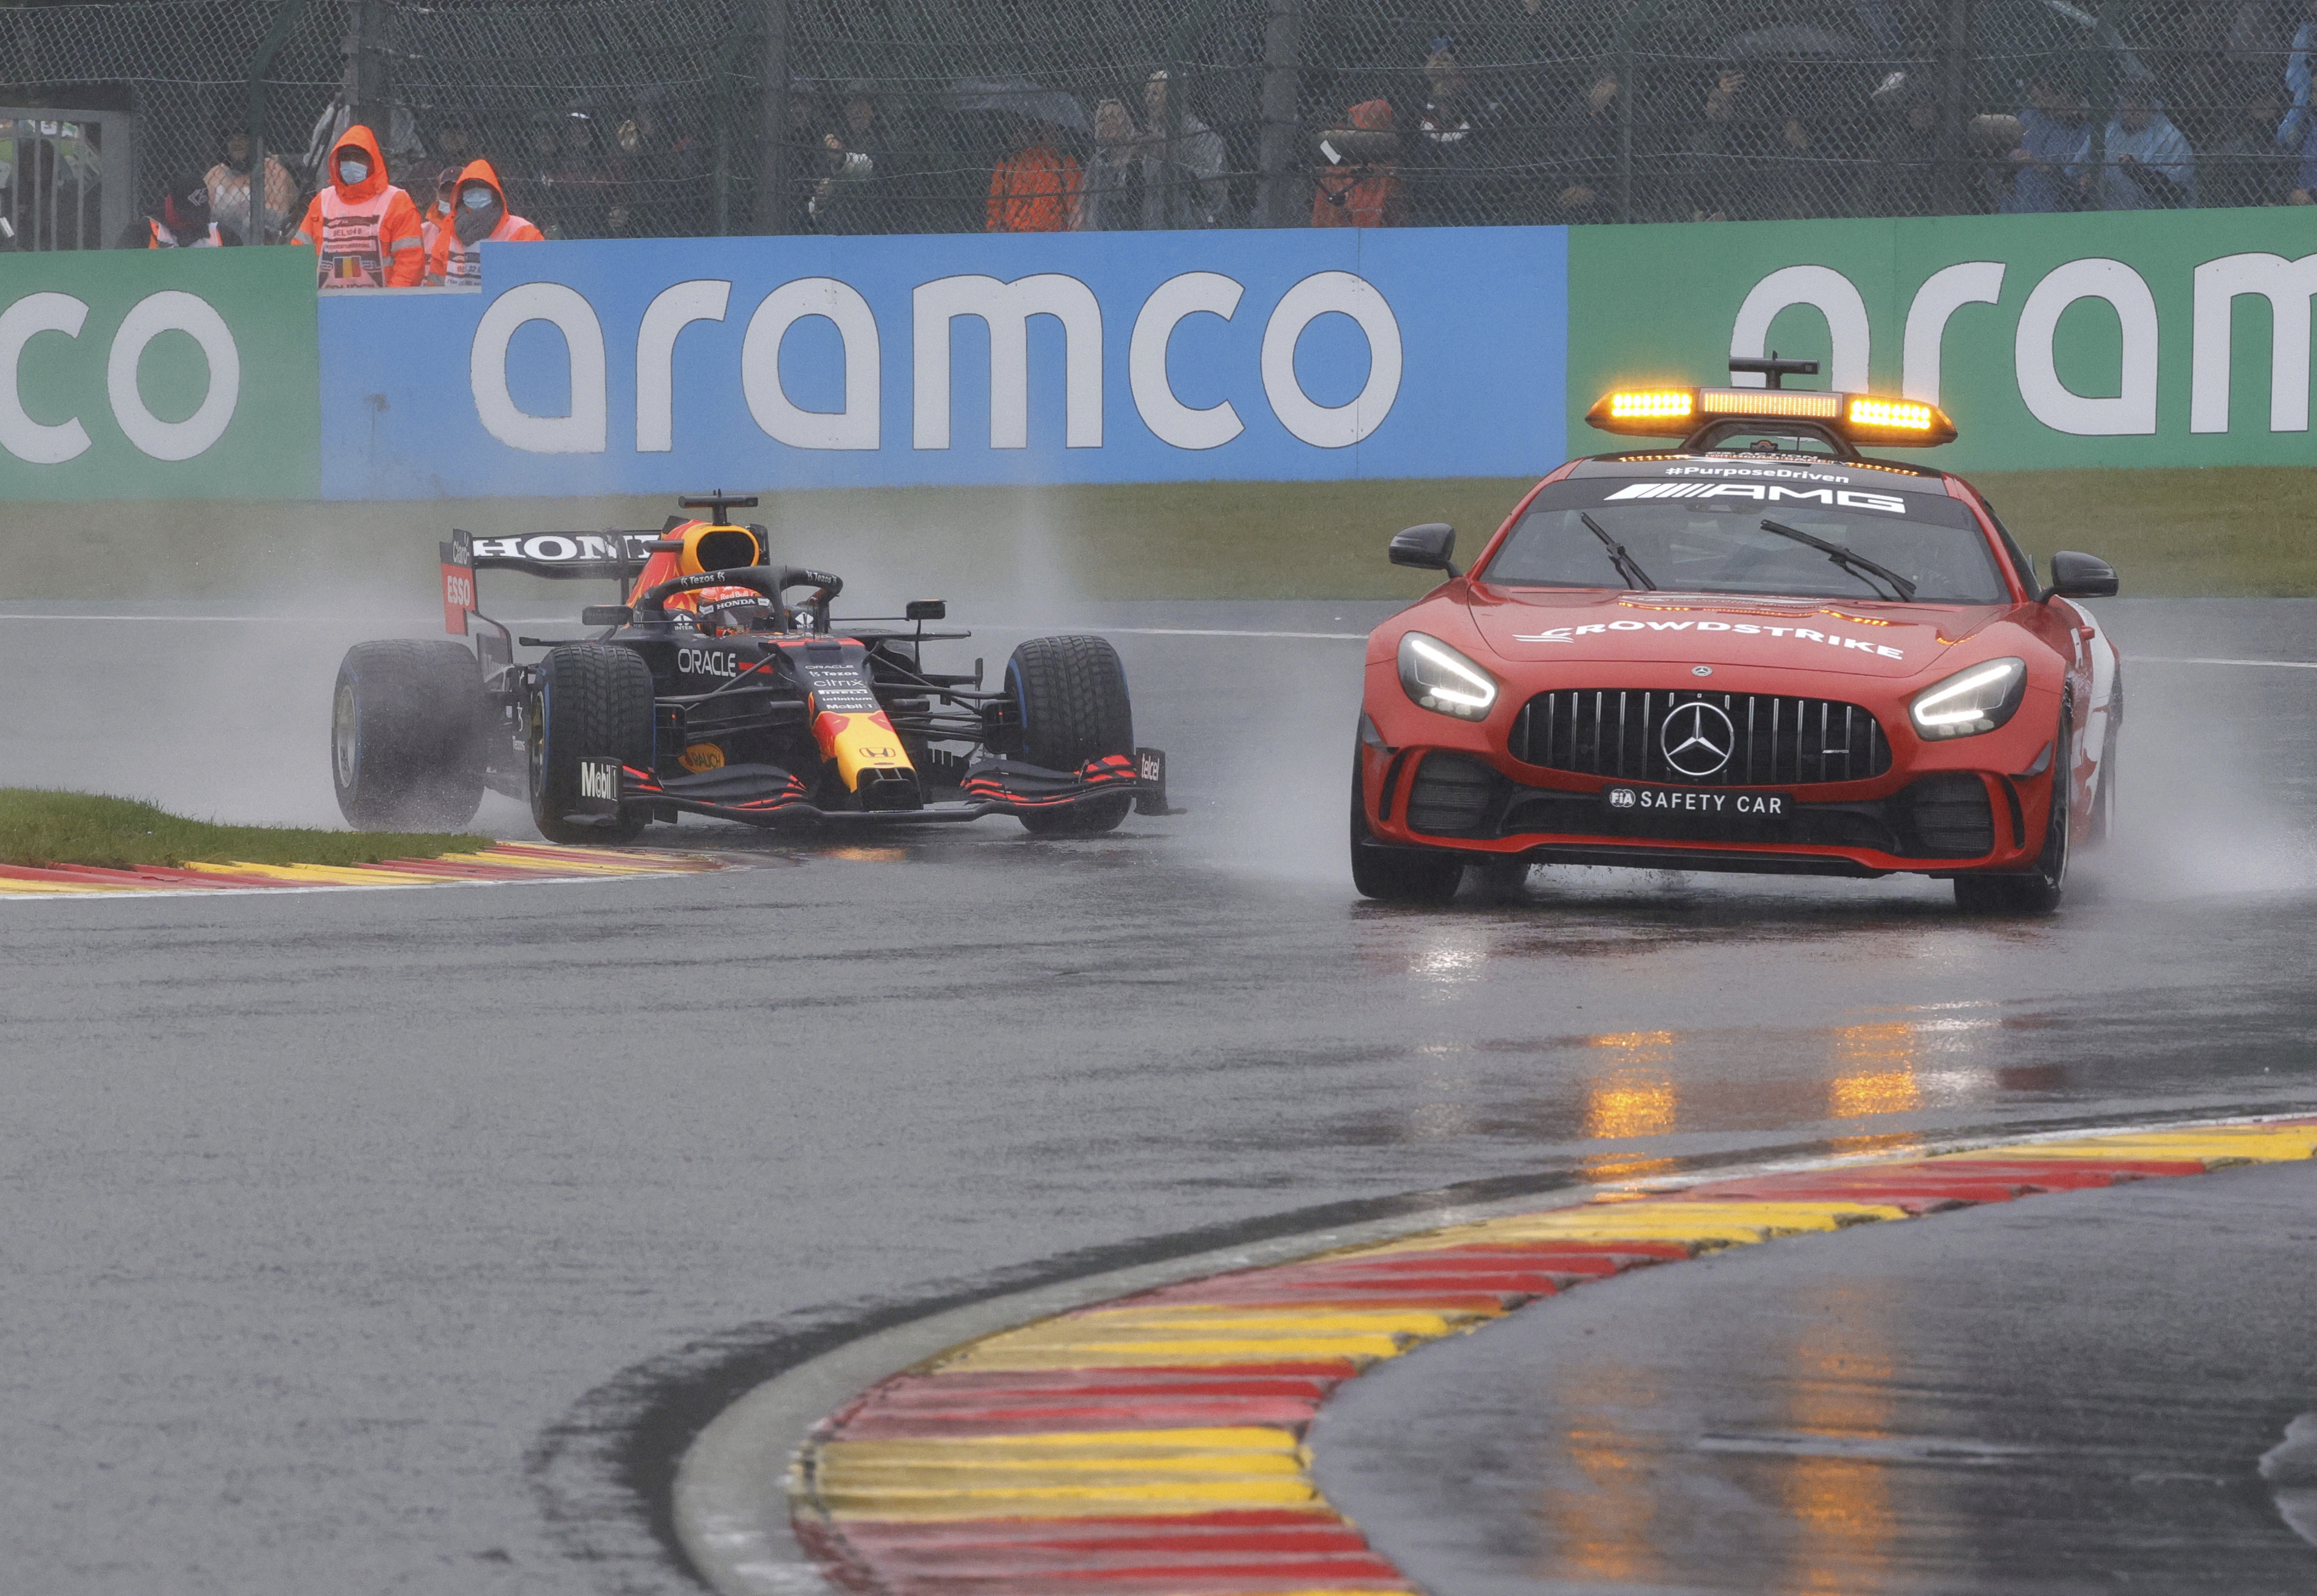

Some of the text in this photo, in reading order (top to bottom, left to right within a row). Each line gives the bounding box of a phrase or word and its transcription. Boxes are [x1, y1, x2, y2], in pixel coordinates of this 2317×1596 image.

[470, 270, 1403, 453] aramco
[1665, 466, 1849, 484] #PurposeDriven
[1701, 484, 1906, 513] AMG
[690, 575, 714, 584] Tezos
[813, 572, 832, 583] Tezos
[717, 598, 756, 610] HONDA
[720, 591, 734, 600] Red
[1541, 620, 1904, 660] CROWDSTRIKE
[678, 648, 736, 677] ORACLE
[813, 679, 864, 687] citrix
[581, 762, 611, 800] Mobil
[1640, 791, 1726, 811] SAFETY
[1737, 796, 1782, 814] CAR
